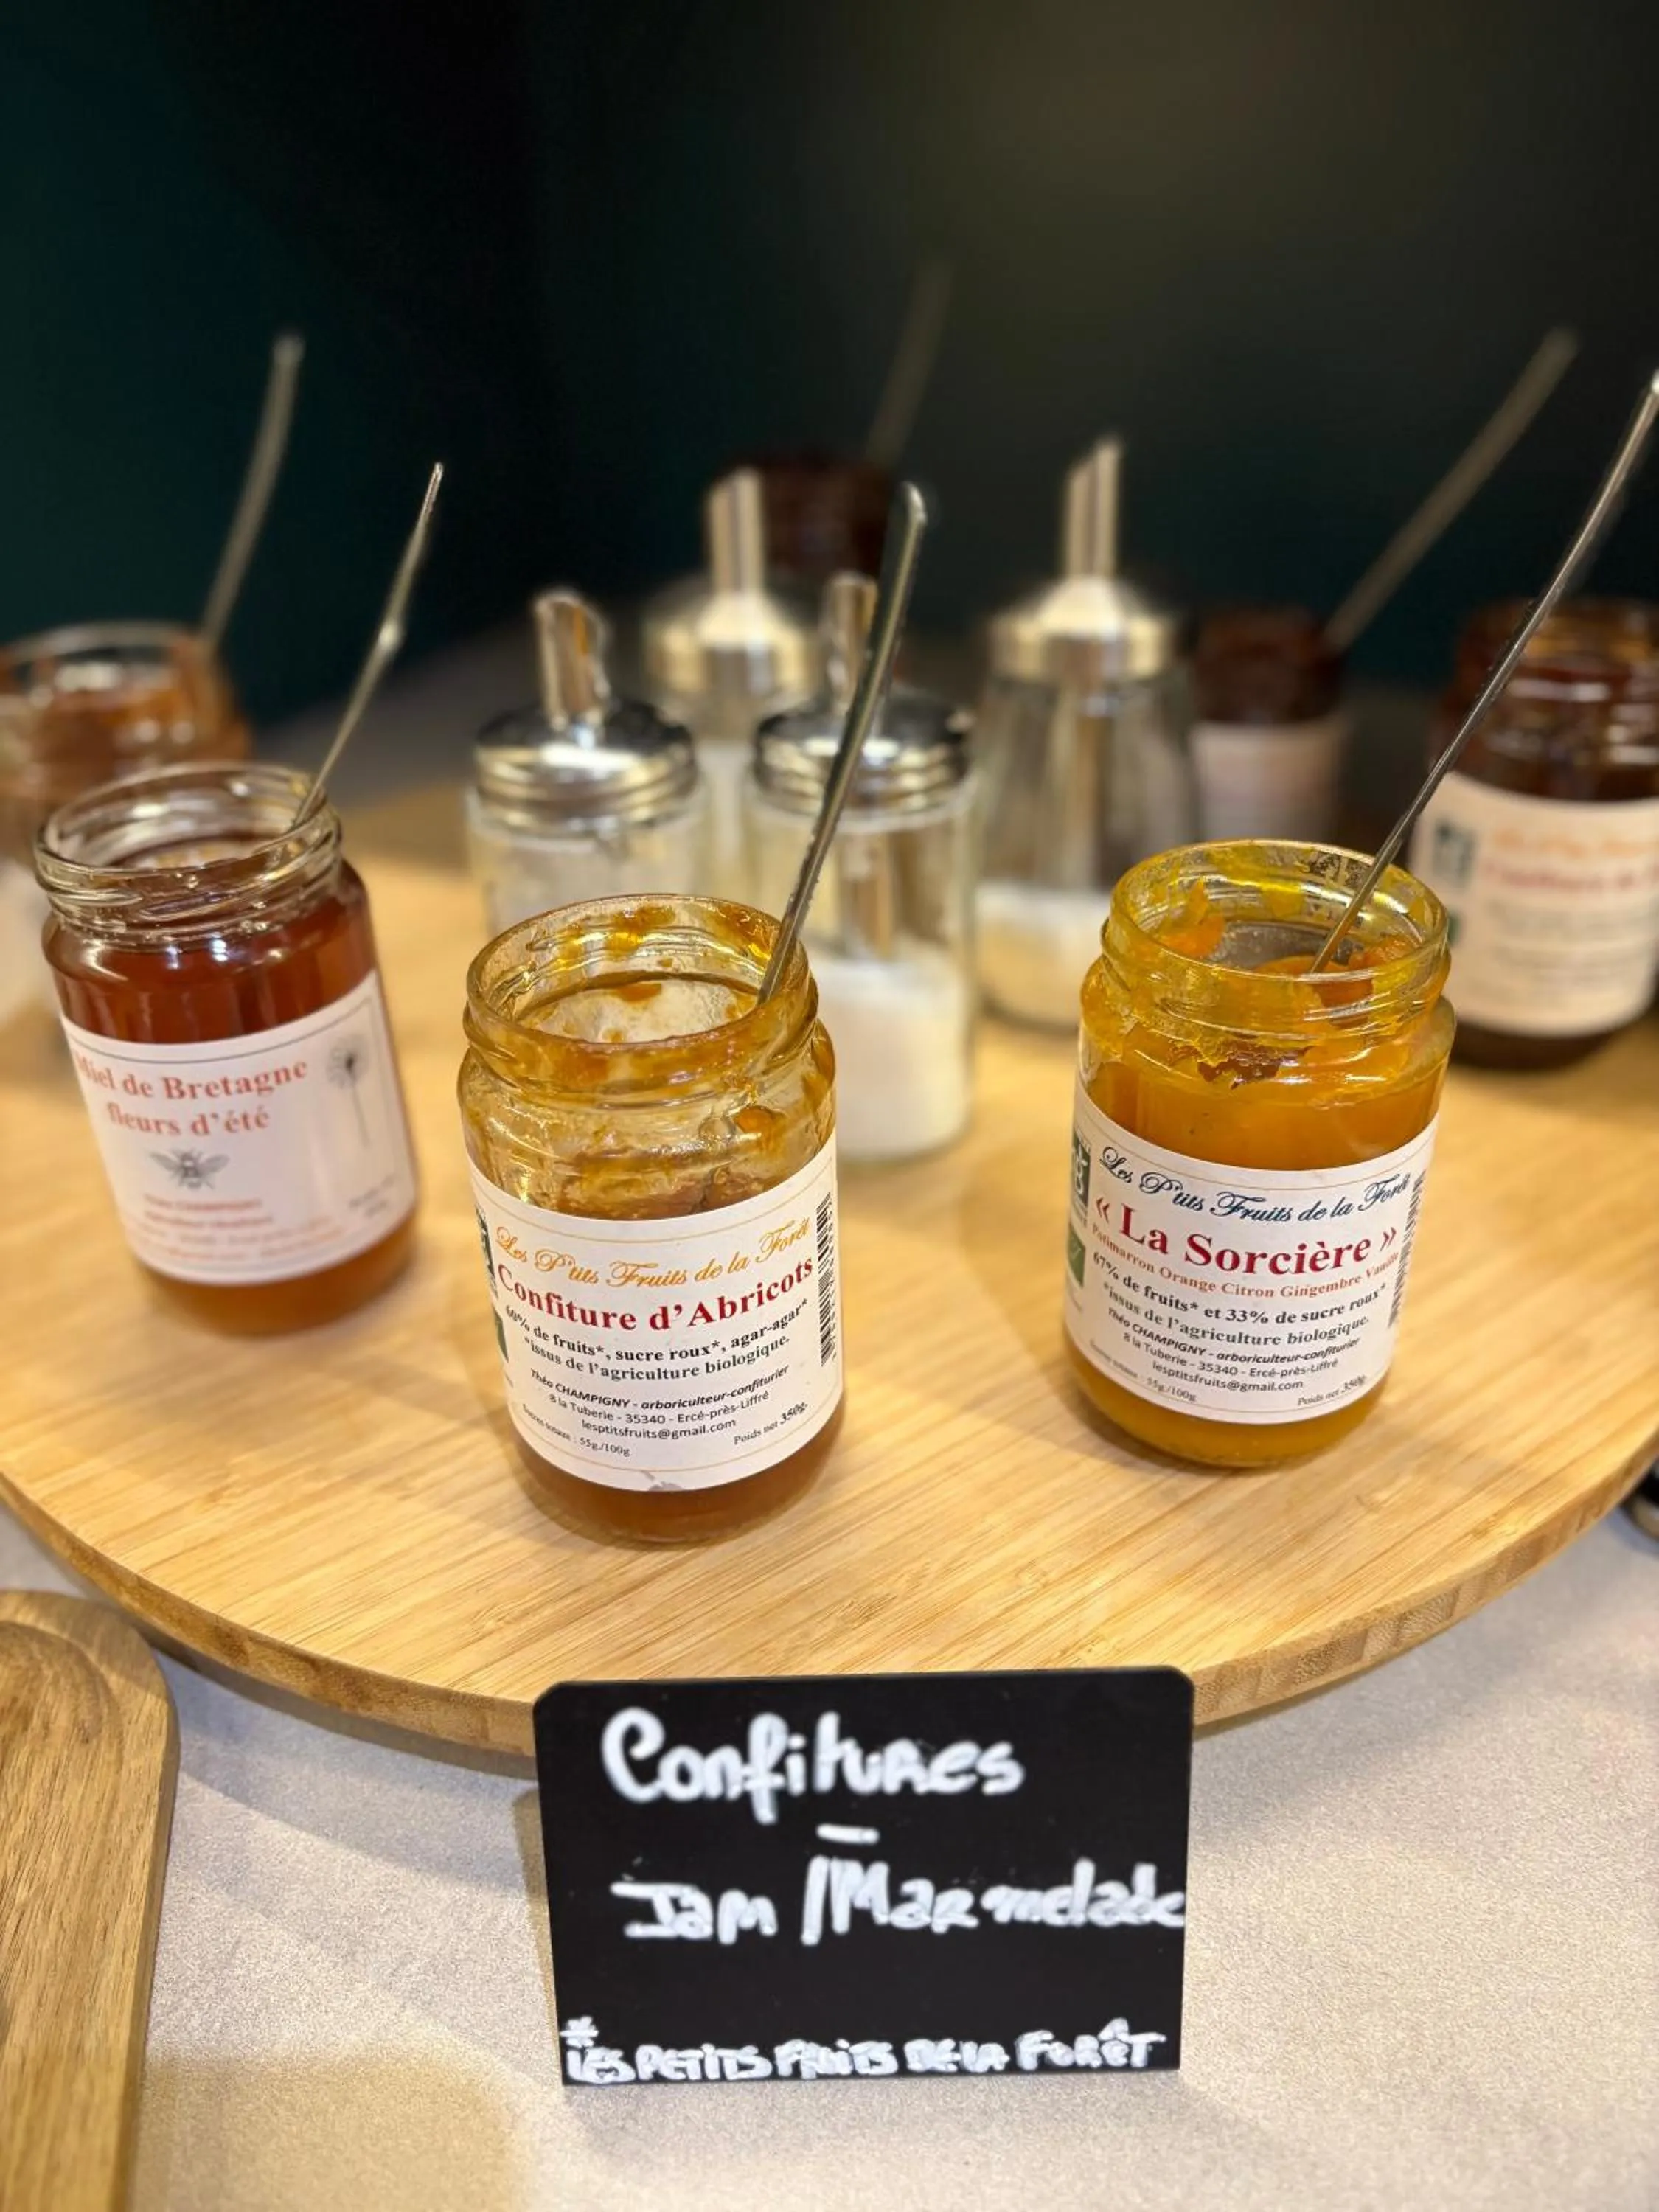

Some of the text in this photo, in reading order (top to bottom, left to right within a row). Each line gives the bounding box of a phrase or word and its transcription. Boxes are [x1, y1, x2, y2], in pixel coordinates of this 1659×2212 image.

[74, 1052, 308, 1099] Miel de Bretagne
[107, 1102, 270, 1137] fleurs d'été
[1099, 1147, 1133, 1183] Les
[1210, 1191, 1293, 1221] Fruits
[1297, 1200, 1326, 1221] de
[1330, 1197, 1354, 1217] la
[495, 1227, 527, 1262] Les
[606, 1260, 687, 1287] Fruits
[695, 1258, 723, 1281] de
[728, 1251, 750, 1273] la
[1119, 1203, 1169, 1255] La
[1185, 1234, 1371, 1275] Sorcière
[498, 1264, 636, 1331] Confiture
[650, 1257, 813, 1331] d'Abricots
[1093, 1252, 1119, 1281] 67%
[1123, 1275, 1140, 1292] de
[1204, 1308, 1222, 1319] et
[1225, 1309, 1269, 1324] 33%
[1276, 1311, 1297, 1324] de
[1300, 1304, 1345, 1322] sucre
[1160, 1266, 1216, 1293] Orange
[1221, 1282, 1274, 1298] Citron
[1280, 1275, 1361, 1298] Gingembre
[534, 1326, 549, 1341] de
[616, 1349, 664, 1361] sucre
[1108, 1307, 1130, 1328] Théo
[1132, 1323, 1206, 1357] CHAMPIGNY
[1217, 1337, 1360, 1363] arboriculteur-confiturier
[1144, 1309, 1163, 1325] de
[1169, 1317, 1281, 1345] l'agriculture
[1287, 1315, 1369, 1345] biologique.
[566, 1358, 584, 1372] de
[589, 1363, 699, 1382] l'agriculture
[705, 1335, 790, 1374] biologique.
[1133, 1335, 1141, 1349] la
[1144, 1343, 1186, 1366] Tuberie
[1197, 1360, 1237, 1376] 35340
[1152, 1361, 1303, 1392] lesptitsfruits@gmail.com
[531, 1368, 553, 1388] Théo
[555, 1383, 630, 1408] CHAMPIGNY
[641, 1365, 790, 1410] arboriculteur-confiturier
[558, 1397, 568, 1408] la
[570, 1402, 614, 1421] Tuberie
[626, 1413, 665, 1424] 35340
[678, 1391, 769, 1423] Ercé-près-Liffré
[582, 1419, 737, 1440] lesptitsfruits@gmail.com
[734, 1427, 762, 1444] Poids
[763, 1421, 777, 1433] net
[610, 1882, 778, 1945] Jam
